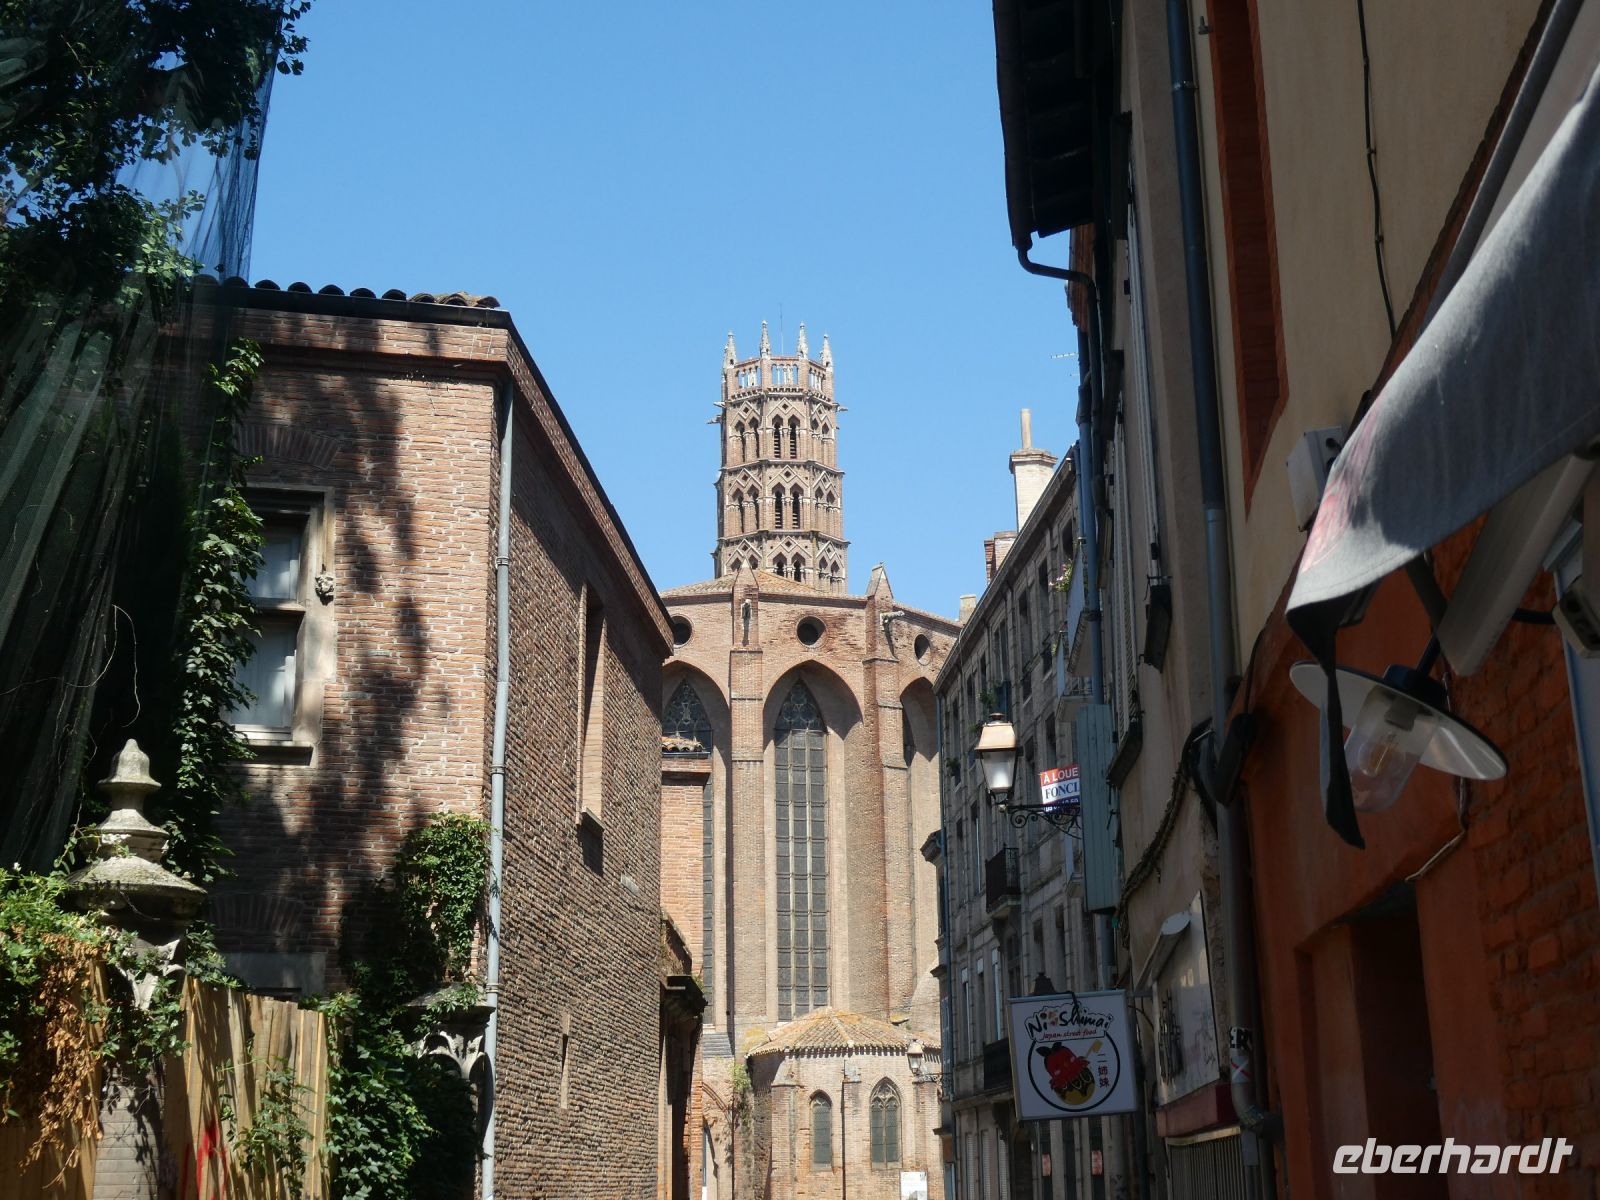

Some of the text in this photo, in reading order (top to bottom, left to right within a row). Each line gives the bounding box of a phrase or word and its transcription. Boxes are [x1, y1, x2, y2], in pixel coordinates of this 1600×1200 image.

[1052, 767, 1079, 781] LOUE
[1045, 782, 1078, 799] FONCI
[1059, 1005, 1112, 1029] Shimai
[1081, 1029, 1097, 1039] food
